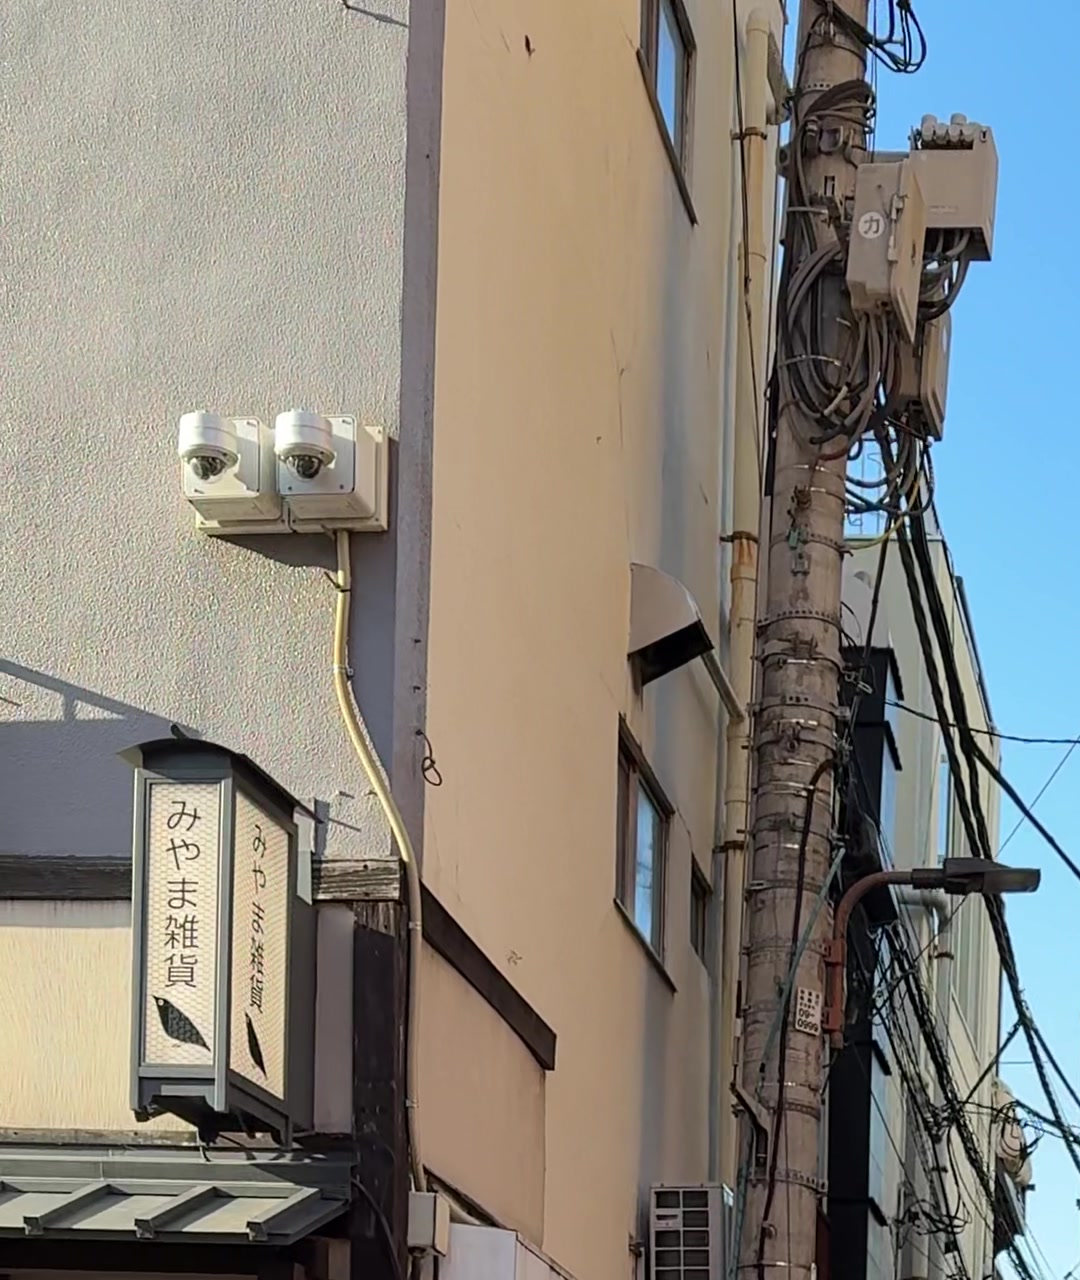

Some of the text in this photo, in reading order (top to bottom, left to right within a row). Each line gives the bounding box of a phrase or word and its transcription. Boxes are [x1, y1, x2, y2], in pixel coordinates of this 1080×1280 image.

[164, 801, 202, 988] みやま雑貨
[250, 824, 268, 1014] みやま雑貨
